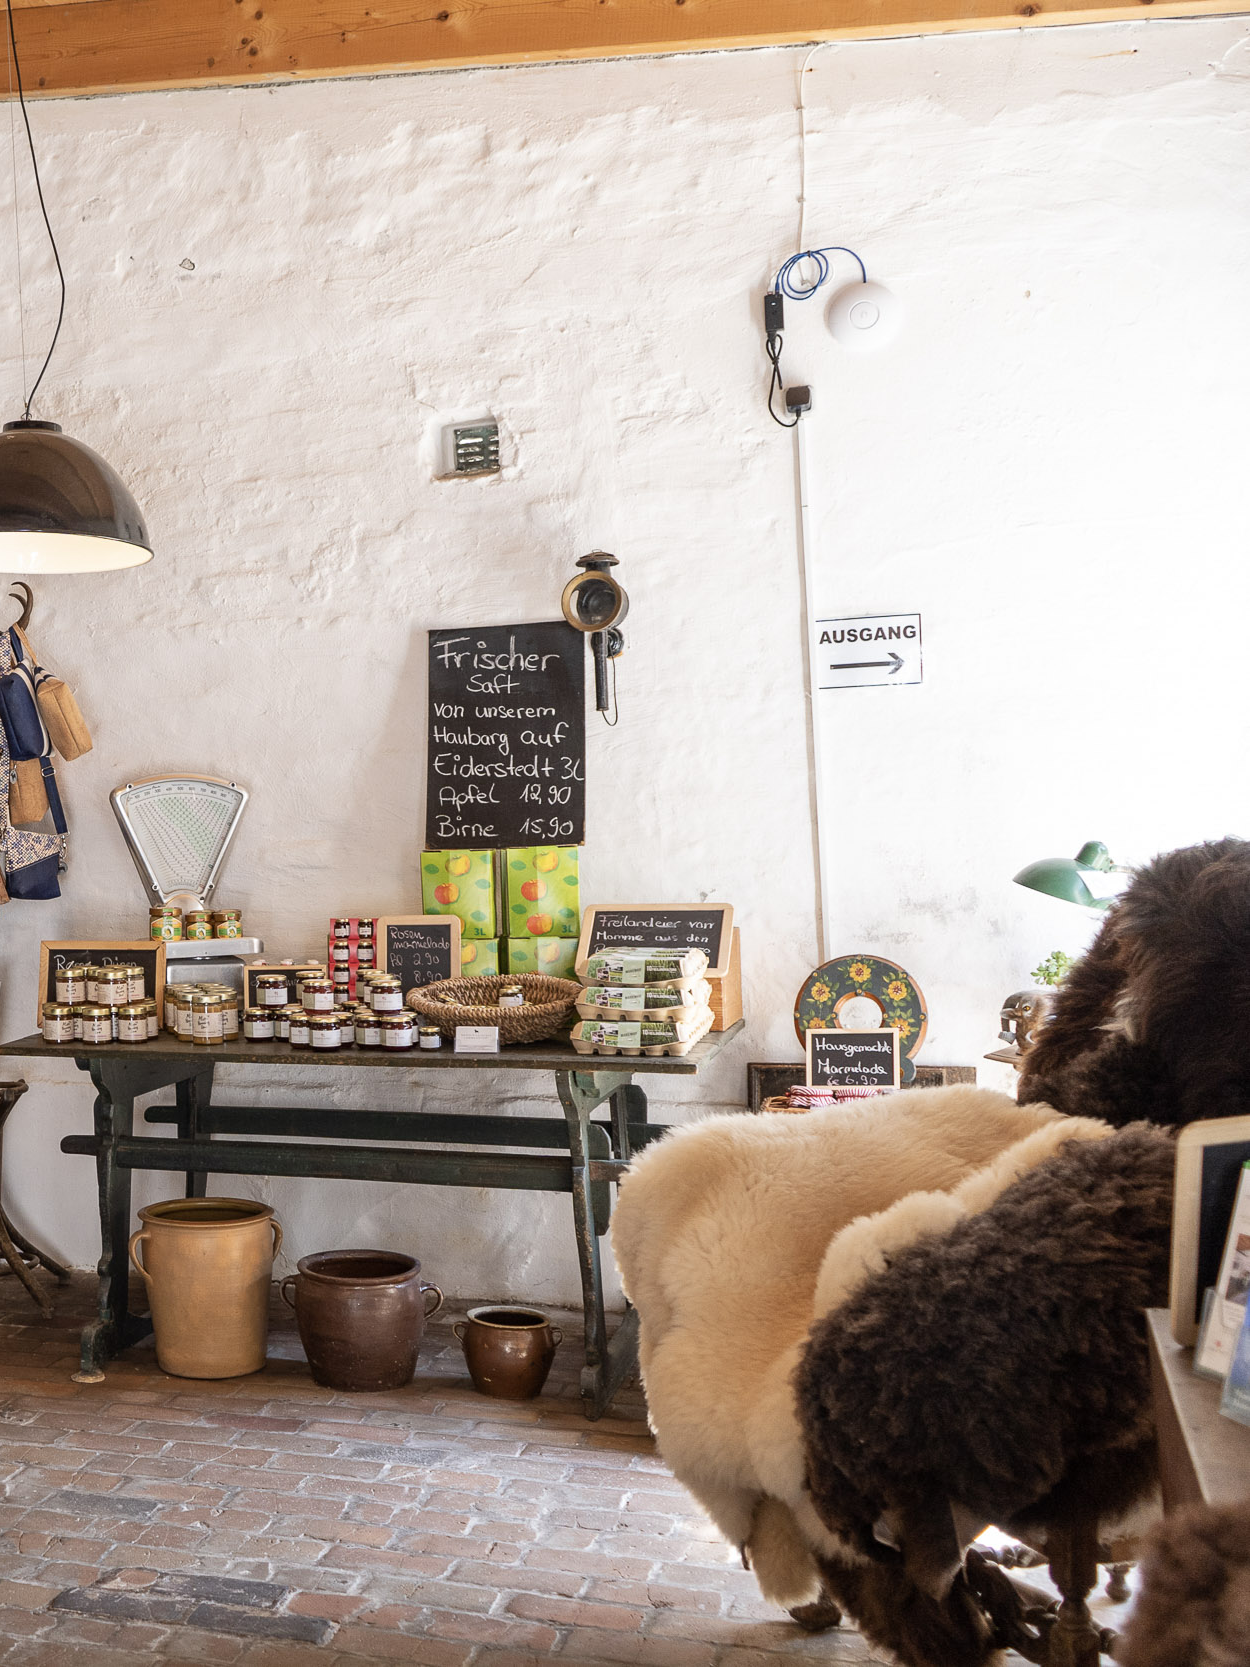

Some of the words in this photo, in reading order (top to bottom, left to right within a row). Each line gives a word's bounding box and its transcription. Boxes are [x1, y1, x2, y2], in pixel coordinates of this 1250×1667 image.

[819, 625, 917, 644] AUSGANG
[433, 635, 560, 671] Frischer
[466, 673, 520, 694] Saft
[475, 704, 556, 719] unserem
[433, 725, 509, 756] Haubarg
[520, 722, 569, 747] auf
[433, 753, 555, 778] Eiderstedt
[439, 783, 500, 812] Apfel
[435, 815, 499, 837] Birne
[519, 816, 574, 839] 15,90
[561, 925, 574, 933] 3L
[598, 914, 681, 928] Freilandeier
[389, 926, 424, 939] Rosen
[474, 928, 486, 936] 3L
[654, 934, 678, 942] aus
[686, 934, 709, 943] den
[817, 1057, 888, 1074] Marmelade
